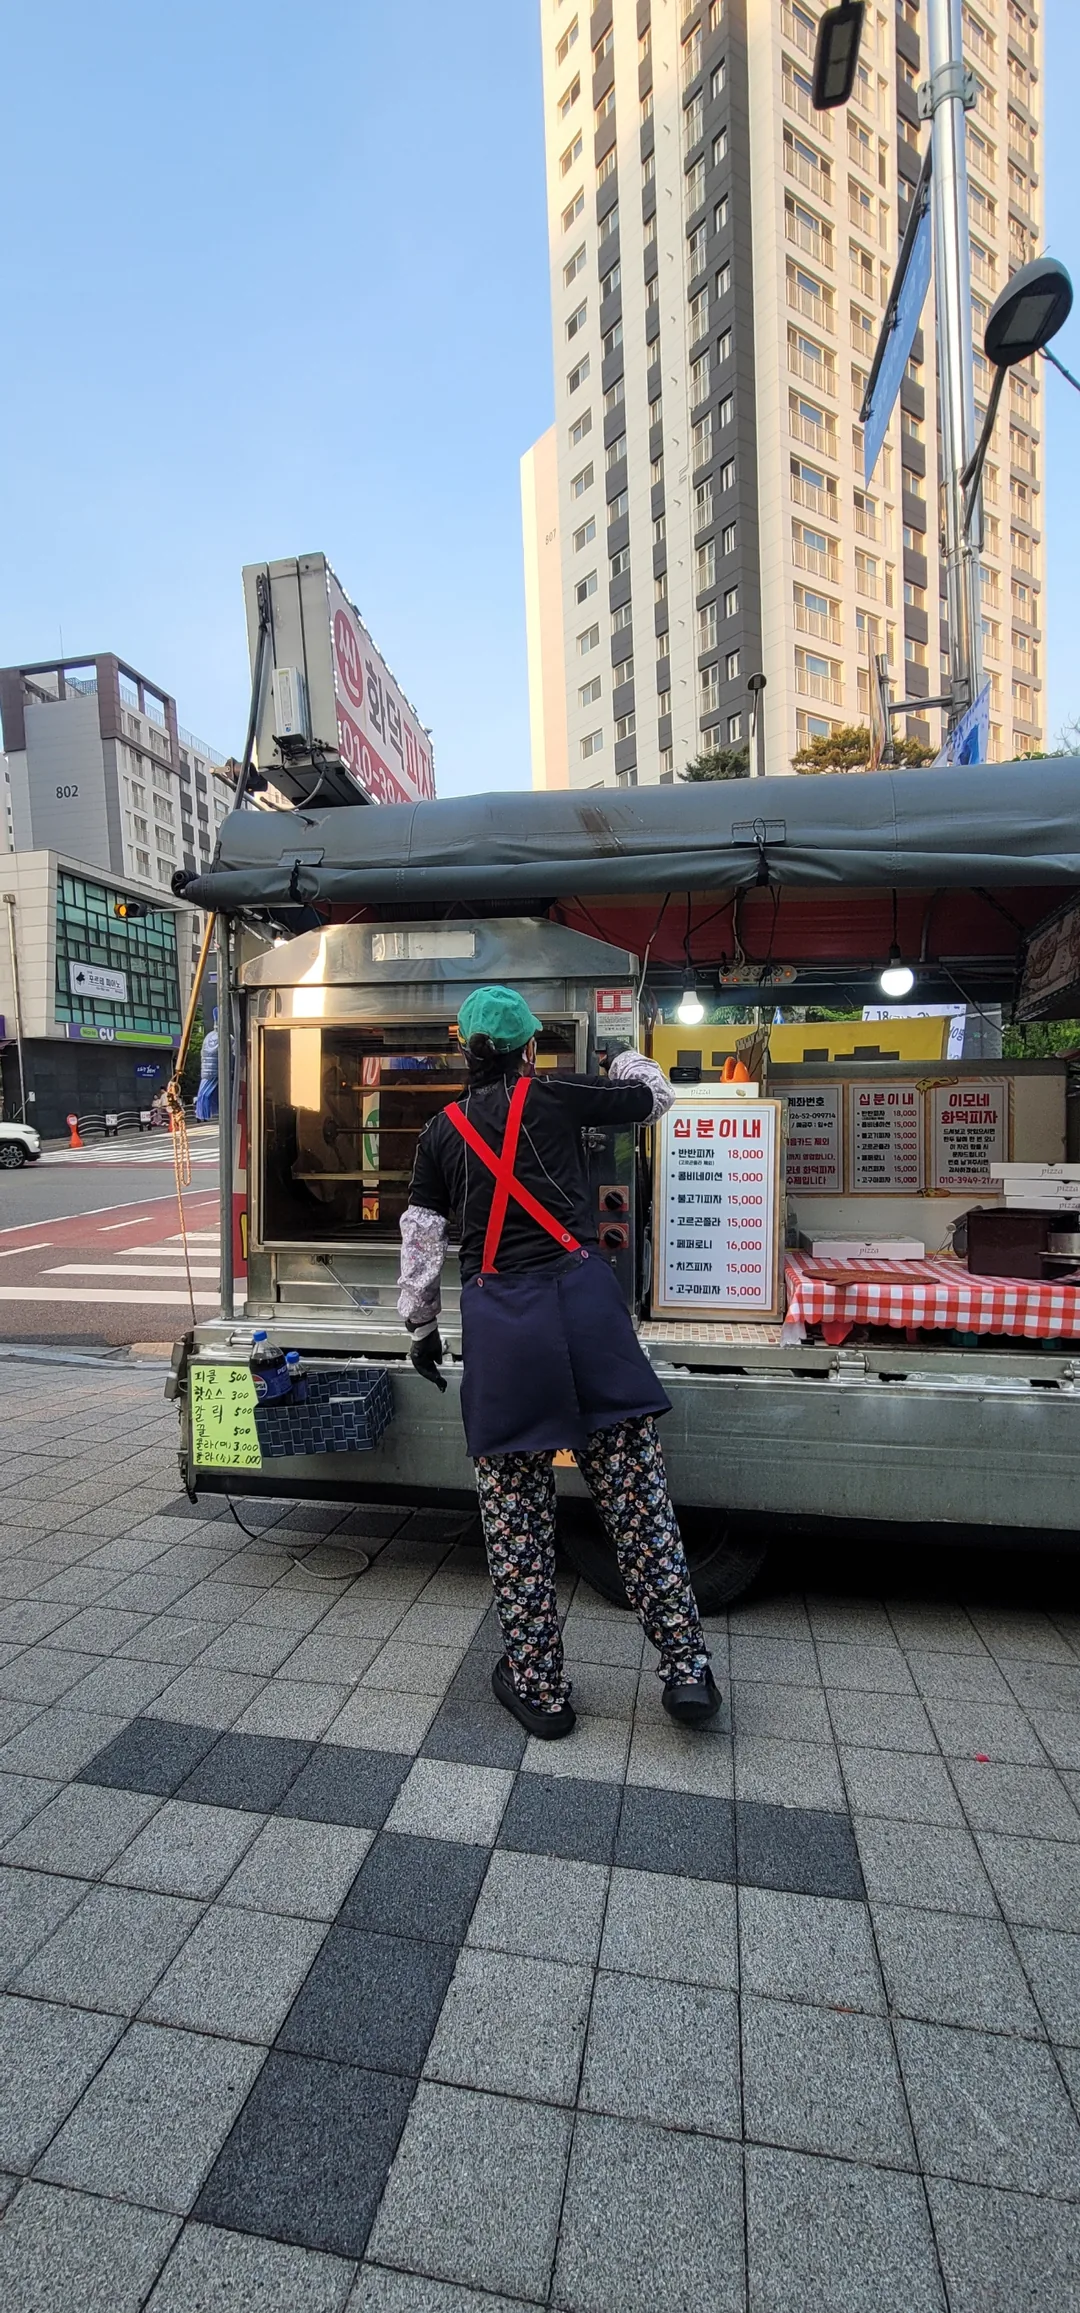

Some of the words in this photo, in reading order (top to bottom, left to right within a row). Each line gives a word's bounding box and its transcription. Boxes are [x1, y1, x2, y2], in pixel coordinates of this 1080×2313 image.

[56, 785, 79, 799] 802
[99, 1027, 114, 1041] CU
[690, 1089, 711, 1097] pizza
[787, 1096, 825, 1107] 계좌번호
[948, 1093, 990, 1107] 이모네
[789, 1112, 836, 1120] 26-52-099714
[940, 1110, 998, 1125] 화덕피자
[678, 1148, 715, 1159] 반반피자
[728, 1149, 763, 1160] 18,000
[678, 1171, 723, 1182] 콤비네이션
[728, 1172, 763, 1183] 15,000
[1039, 1168, 1063, 1178] pizza
[1054, 1185, 1079, 1195] pizza
[677, 1194, 722, 1204] 불고기피자
[728, 1195, 763, 1206] 15,000
[727, 1218, 763, 1229] 15,000
[676, 1239, 712, 1250] 페퍼로니
[726, 1240, 762, 1252] 16,000
[857, 1247, 879, 1257] pizza
[676, 1261, 712, 1272] 치즈피자
[726, 1263, 762, 1274] 15,000
[676, 1284, 721, 1295] 고구마피자
[726, 1286, 761, 1297] 15,000
[194, 1369, 219, 1384] 피클
[228, 1371, 248, 1383] 500
[193, 1386, 226, 1402] 핫소스
[231, 1390, 249, 1401] 300
[234, 1407, 253, 1417] 500
[233, 1426, 251, 1436] 500
